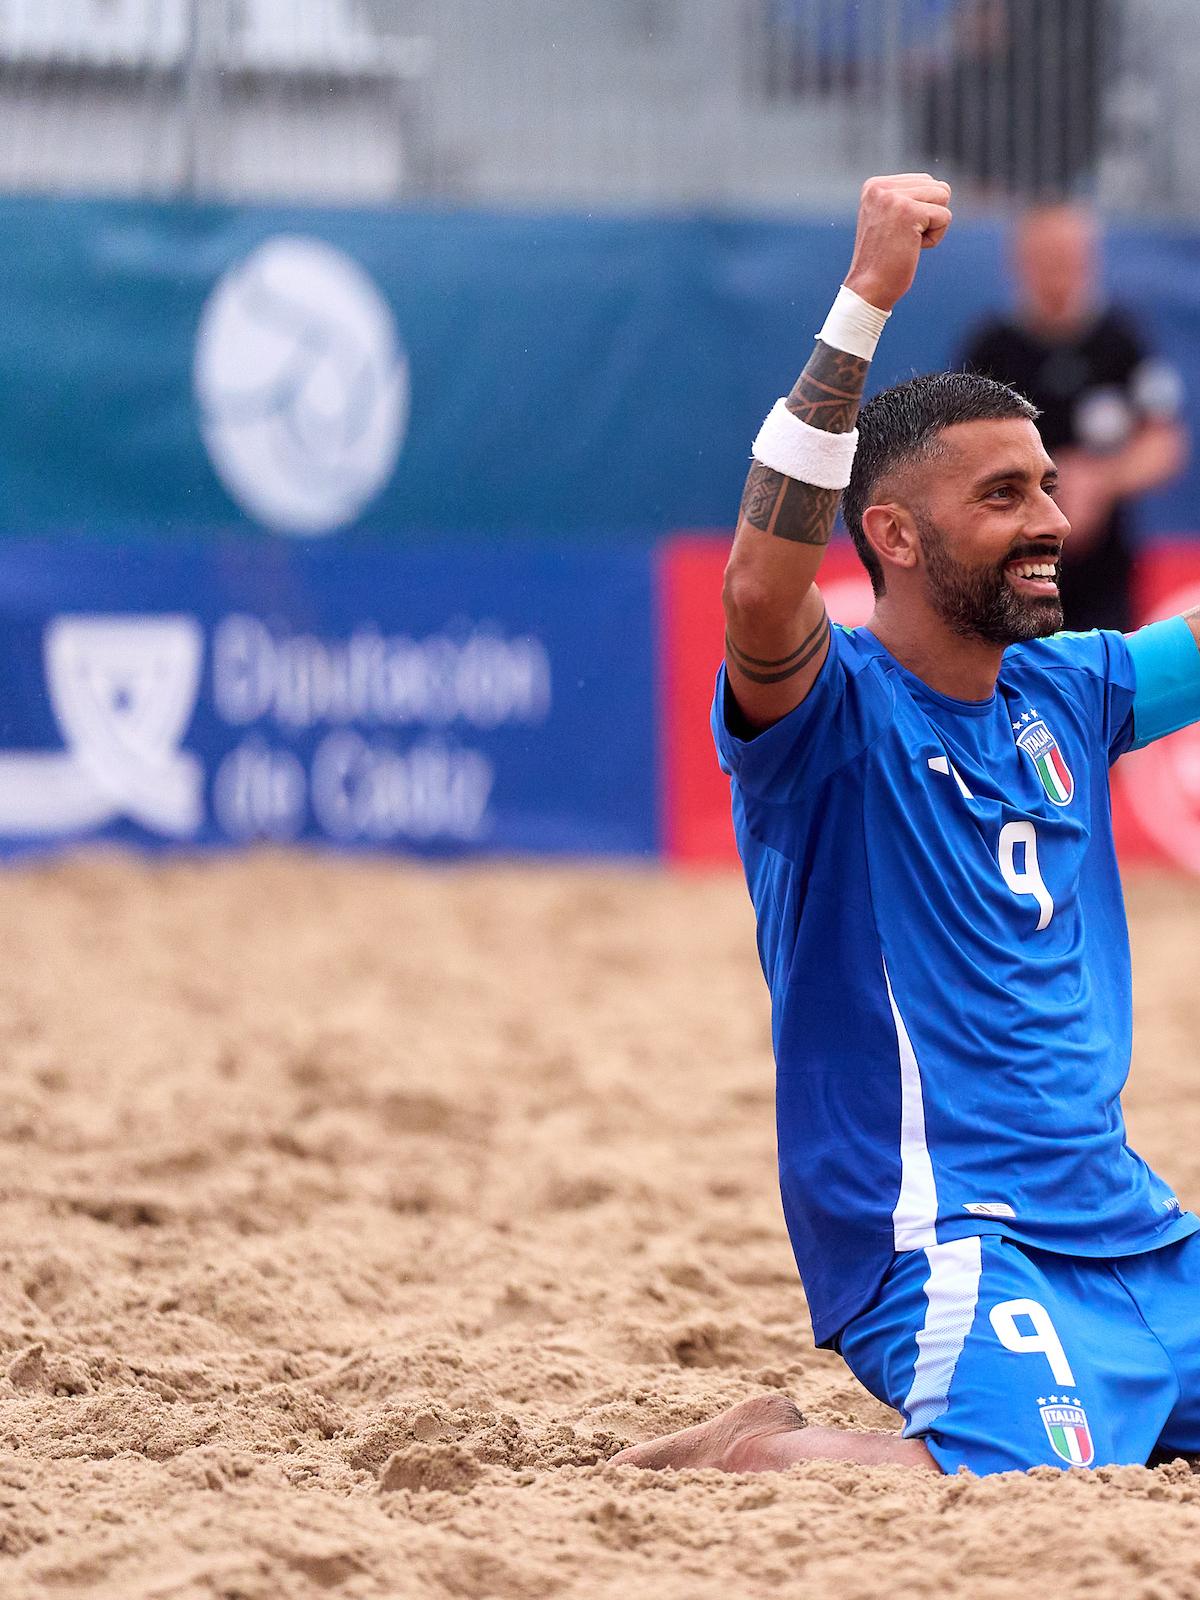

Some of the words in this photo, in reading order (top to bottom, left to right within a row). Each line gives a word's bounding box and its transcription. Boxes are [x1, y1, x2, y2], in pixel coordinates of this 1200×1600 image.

[1022, 727, 1053, 755] ITALIA
[215, 736, 304, 836] de
[998, 821, 1054, 931] 9
[989, 1298, 1076, 1387] 9
[1044, 1410, 1084, 1424] ITALIA
